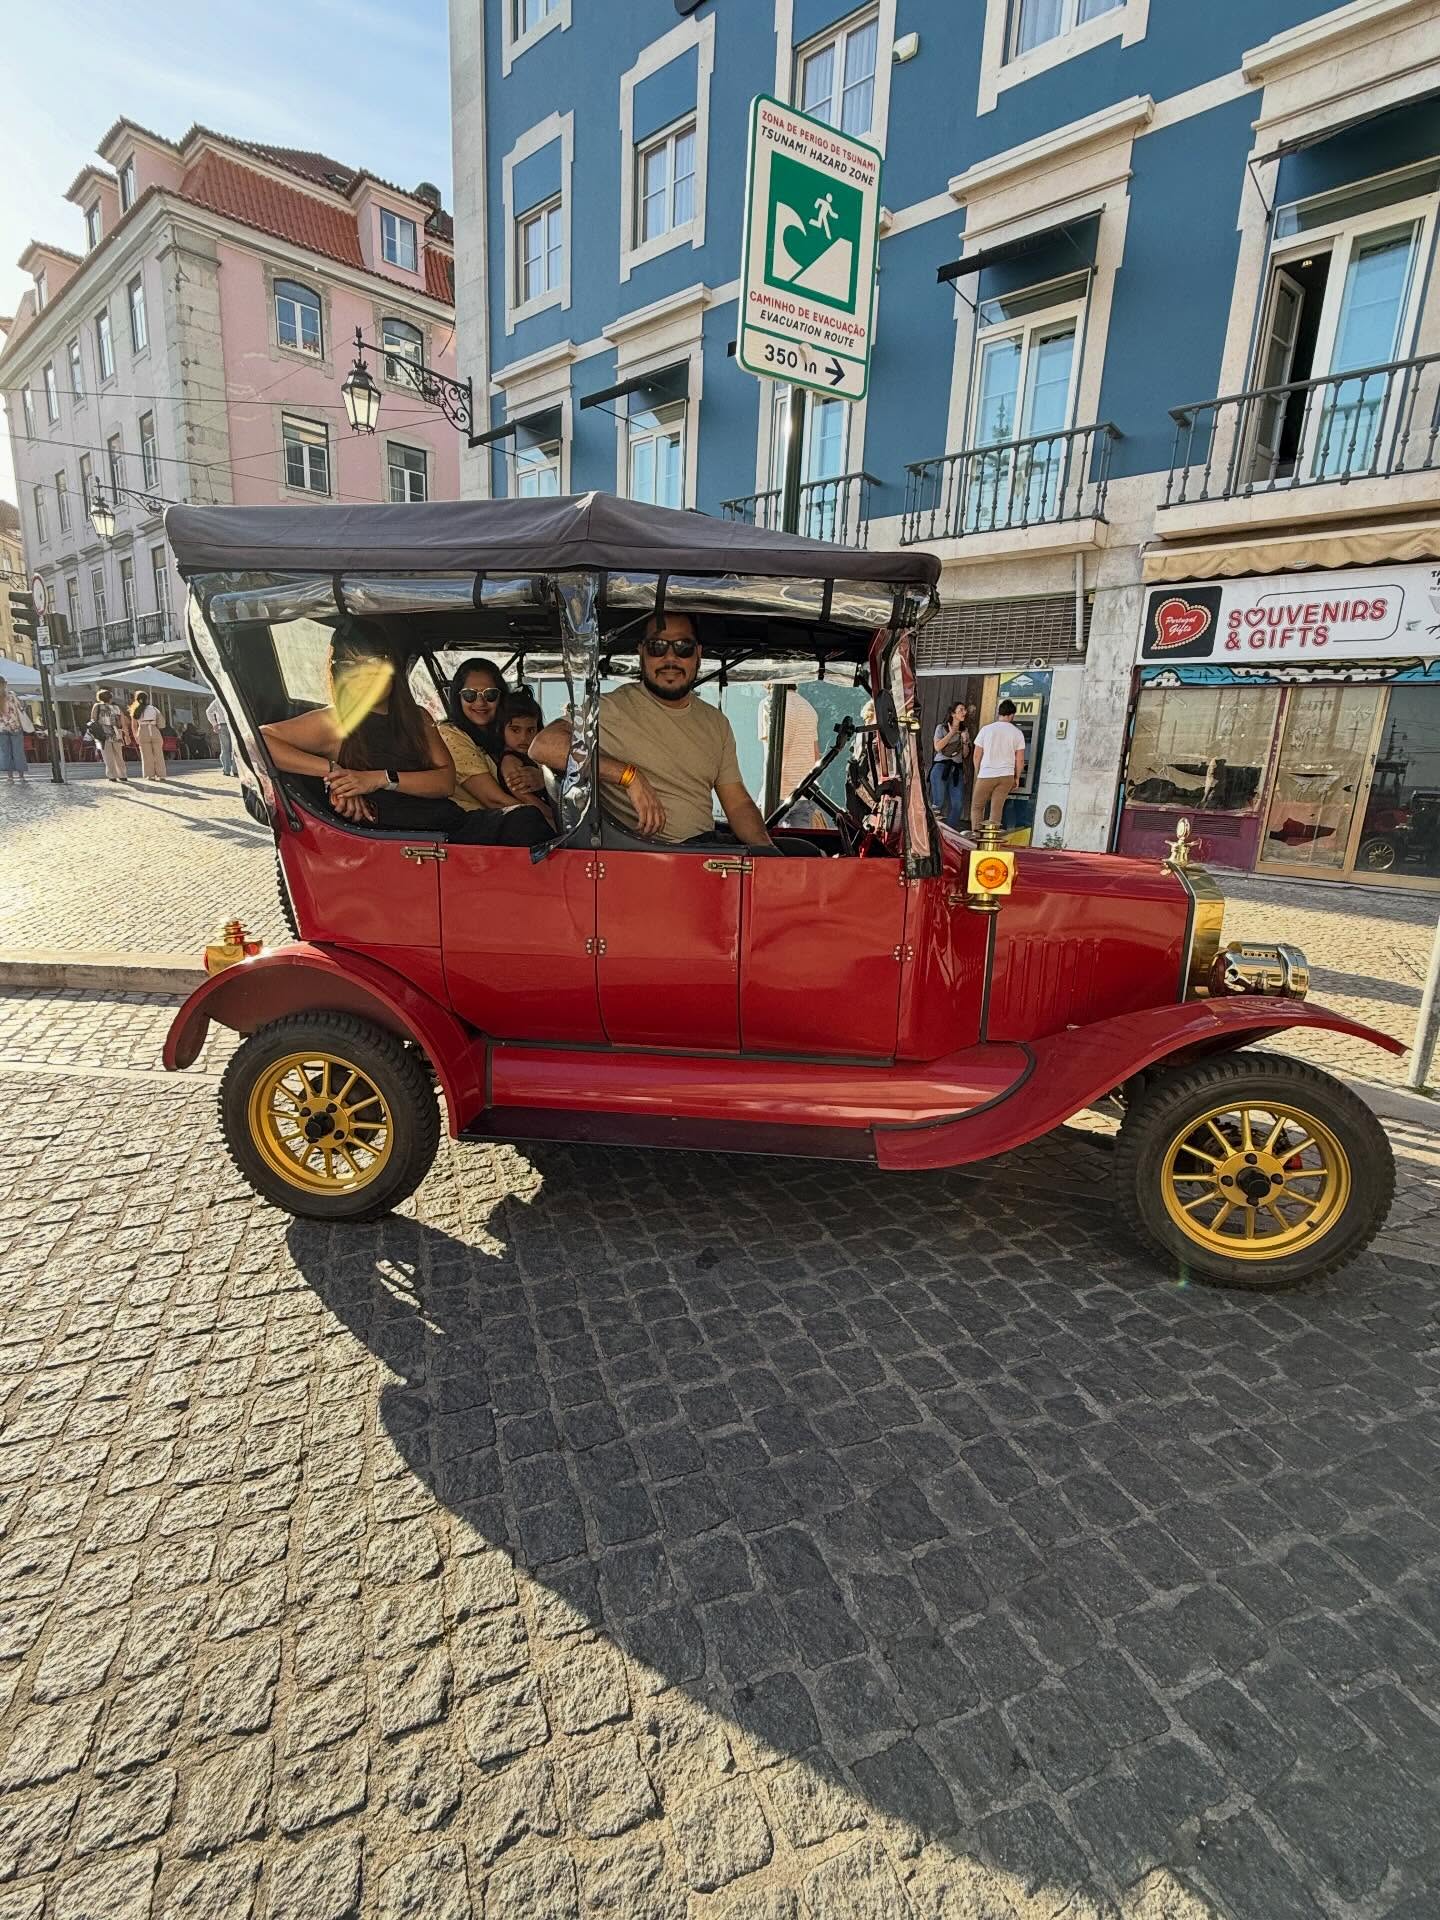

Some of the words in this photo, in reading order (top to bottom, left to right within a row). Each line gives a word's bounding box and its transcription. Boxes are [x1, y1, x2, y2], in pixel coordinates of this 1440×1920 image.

[761, 125, 808, 154] TSUNAMI
[810, 148, 847, 173] HAZARD
[849, 167, 875, 187] ZONE
[762, 110, 785, 129] ZONA
[787, 122, 797, 134] DE
[800, 129, 828, 149] PERIGO
[831, 143, 841, 155] DE
[842, 148, 876, 172] TSUNAMI
[750, 290, 795, 314] CAMINHO
[798, 307, 810, 319] DE
[813, 311, 866, 338] EVACUAÇÃO
[760, 309, 822, 337] EVACUATION
[824, 330, 855, 348] ROUTE
[764, 343, 798, 369] 350
[1225, 630, 1241, 650] &
[1248, 624, 1331, 650] GIFTS
